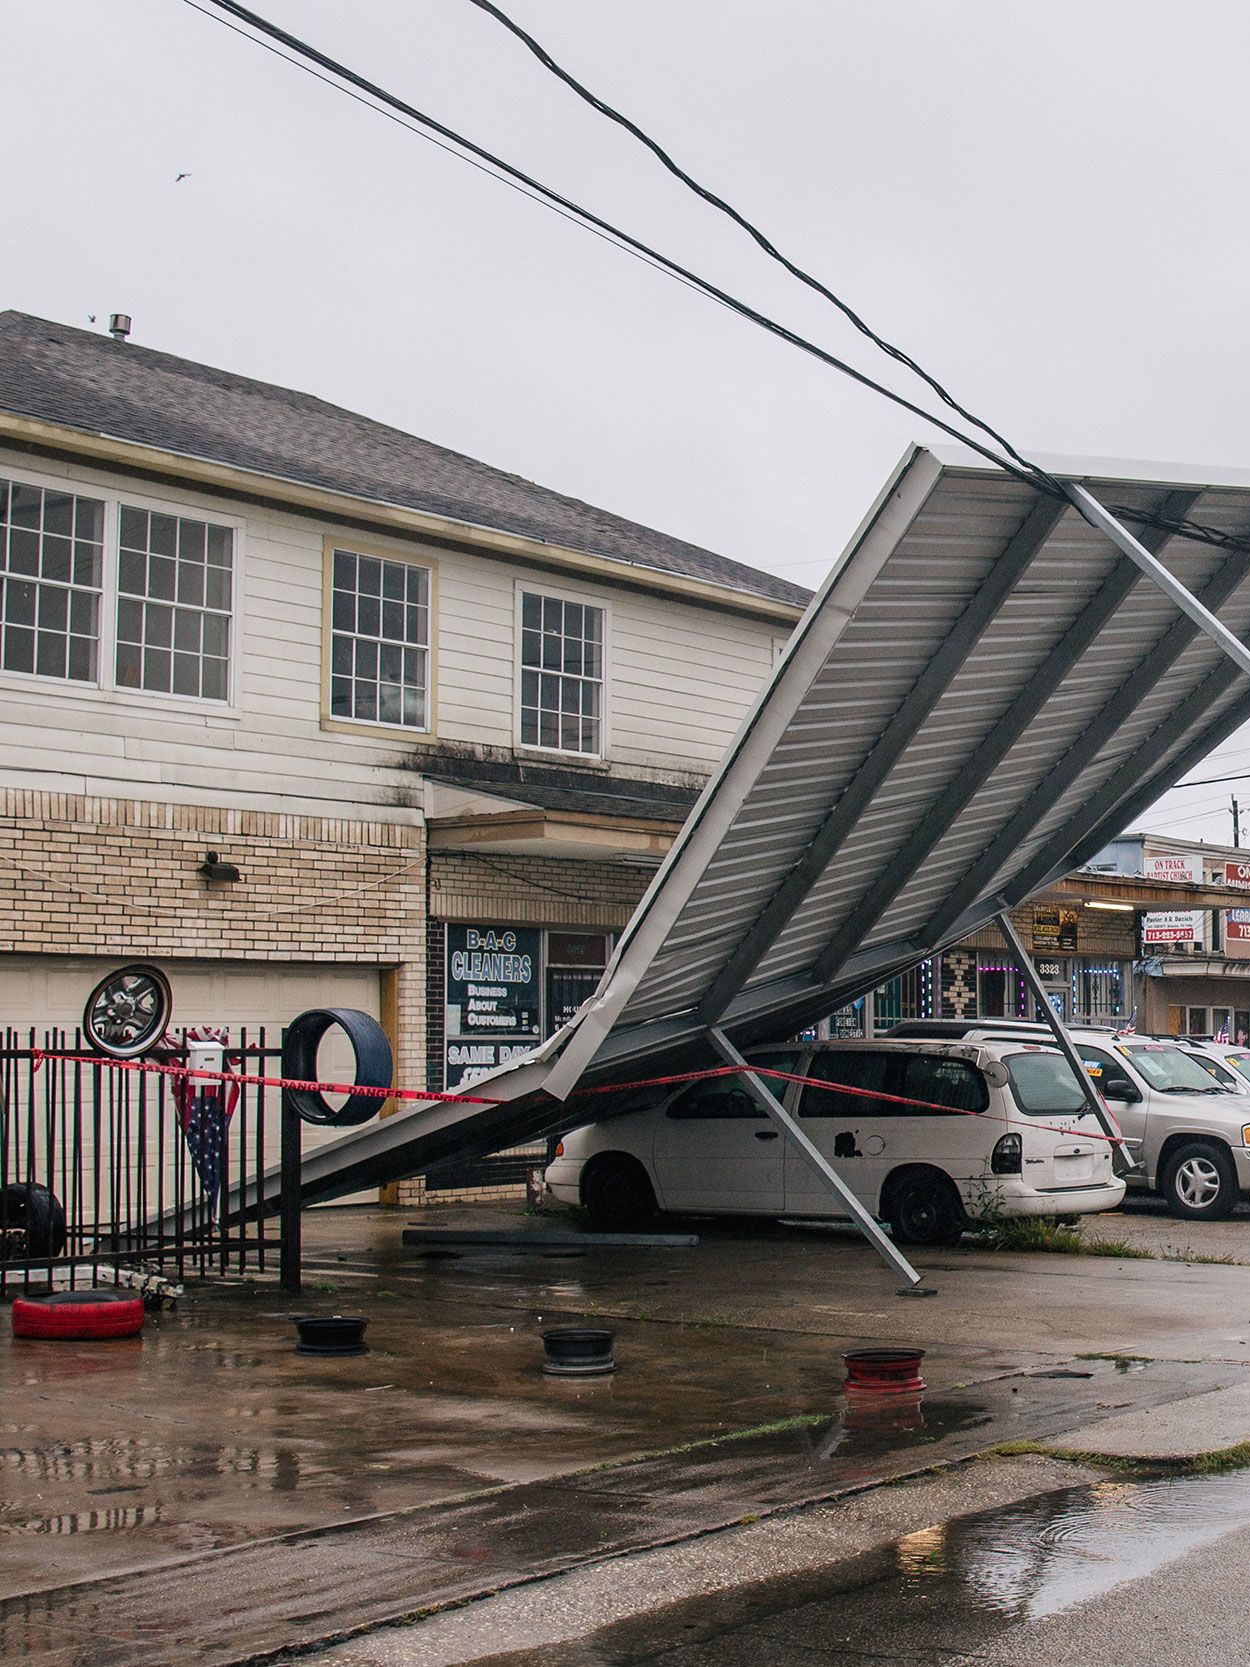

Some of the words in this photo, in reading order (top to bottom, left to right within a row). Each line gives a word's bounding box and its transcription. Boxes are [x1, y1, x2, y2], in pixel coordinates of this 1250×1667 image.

[1154, 860, 1163, 870] ON
[1165, 860, 1185, 869] TRACK
[466, 929, 517, 952] B-A-C
[451, 950, 532, 984] CLEANERS
[467, 983, 508, 998] BUSINESS
[467, 998, 498, 1011] ABOUT
[467, 1012, 517, 1027] CUSTOMERS
[448, 1045, 495, 1065] SAME
[136, 1064, 194, 1078] DANGER
[208, 1072, 264, 1084] DANGER
[280, 1080, 336, 1093] DANGER
[348, 1086, 404, 1099] DANGER
